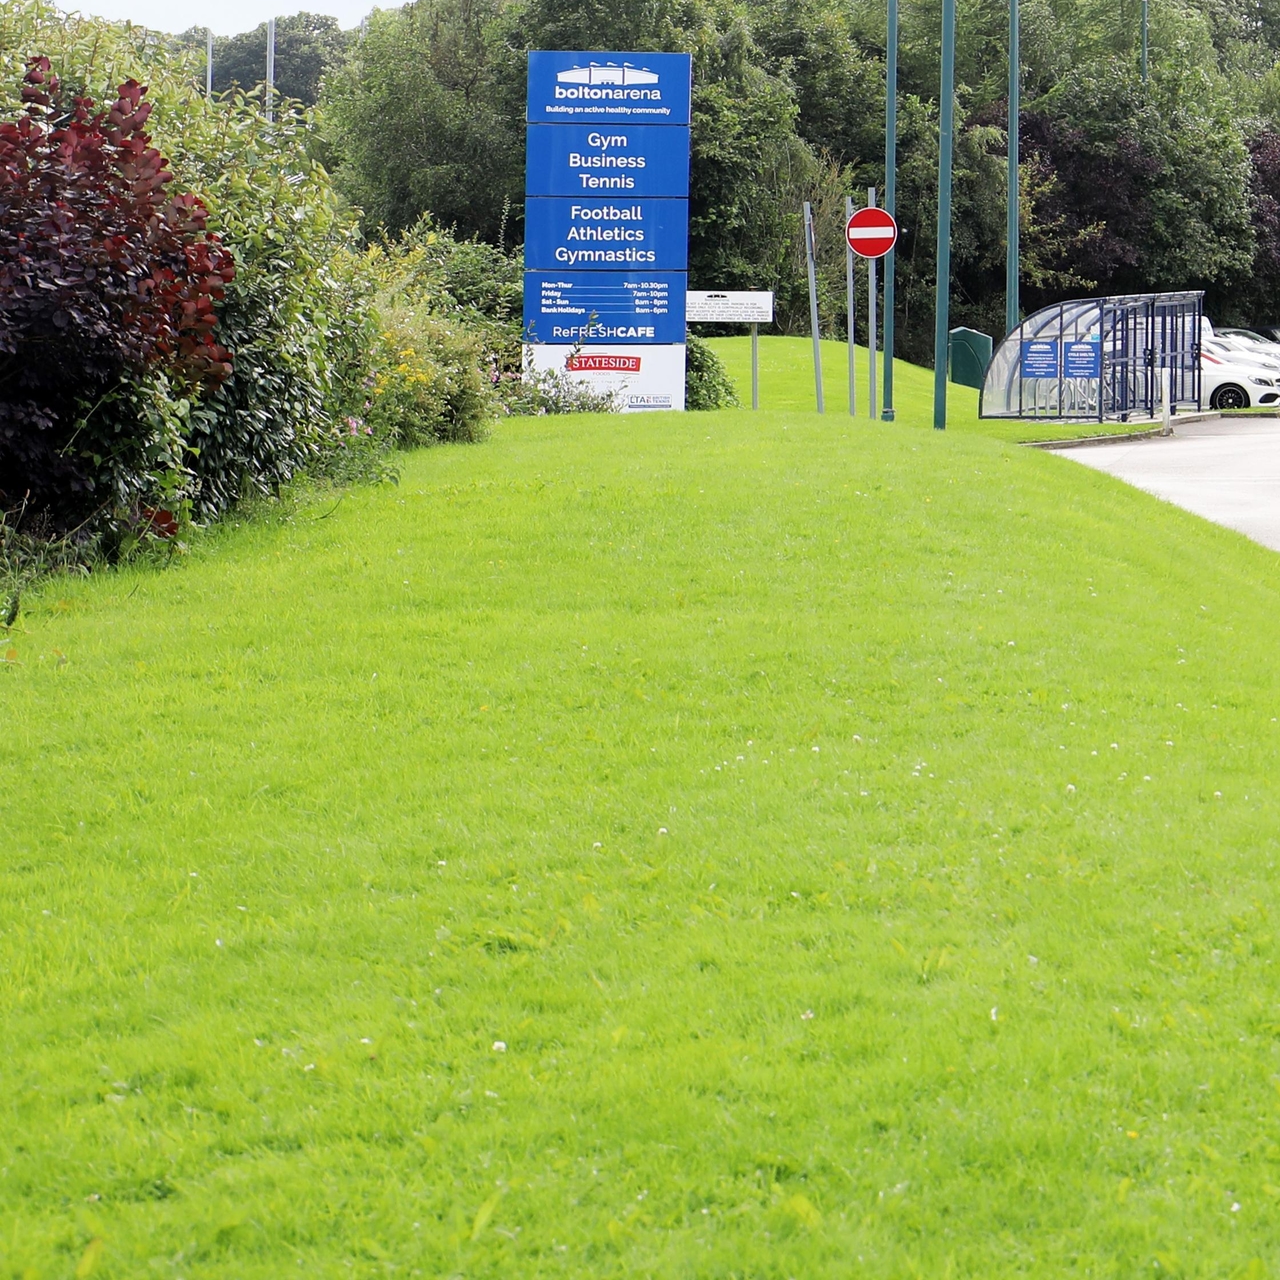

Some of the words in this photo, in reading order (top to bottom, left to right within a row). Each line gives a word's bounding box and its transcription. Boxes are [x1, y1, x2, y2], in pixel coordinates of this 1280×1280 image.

[555, 86, 661, 100] boltonarena
[546, 106, 573, 114] Building
[606, 106, 632, 115] healthy
[632, 107, 670, 115] community
[588, 133, 627, 150] Gym
[569, 154, 645, 168] Business
[579, 174, 634, 188] Tennis
[571, 206, 642, 220] Football
[567, 226, 644, 241] Athletics
[555, 248, 656, 264] Gymnastics
[572, 358, 636, 368] STATESIDE
